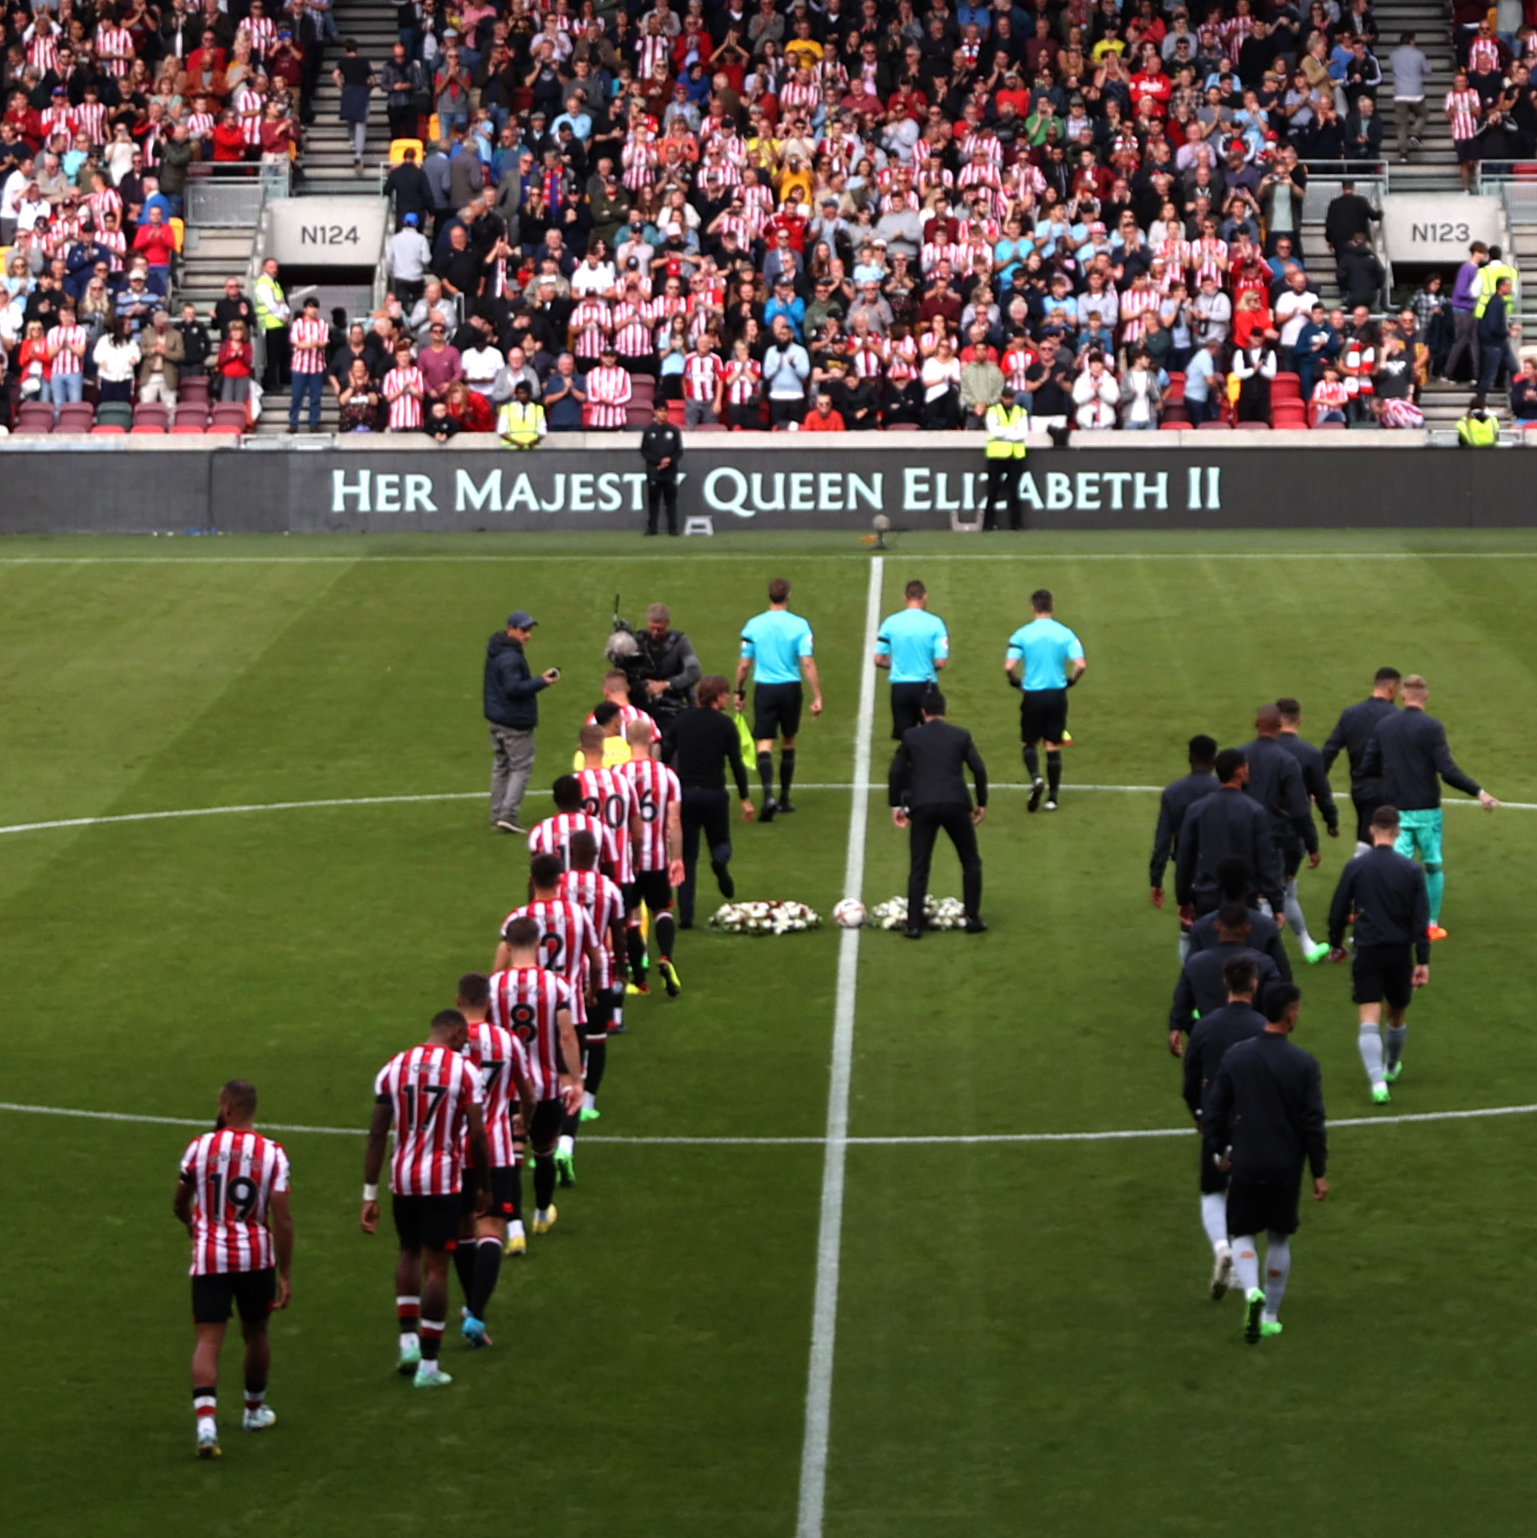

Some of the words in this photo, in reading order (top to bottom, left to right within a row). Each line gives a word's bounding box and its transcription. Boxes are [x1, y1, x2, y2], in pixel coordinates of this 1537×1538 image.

[301, 225, 361, 245] N124
[1411, 222, 1471, 242] N123
[1187, 467, 1221, 509] II
[640, 789, 657, 822] 6
[541, 932, 564, 972] 2
[511, 1003, 537, 1044] 8
[403, 1084, 447, 1131] 17
[210, 1173, 257, 1222] 19
